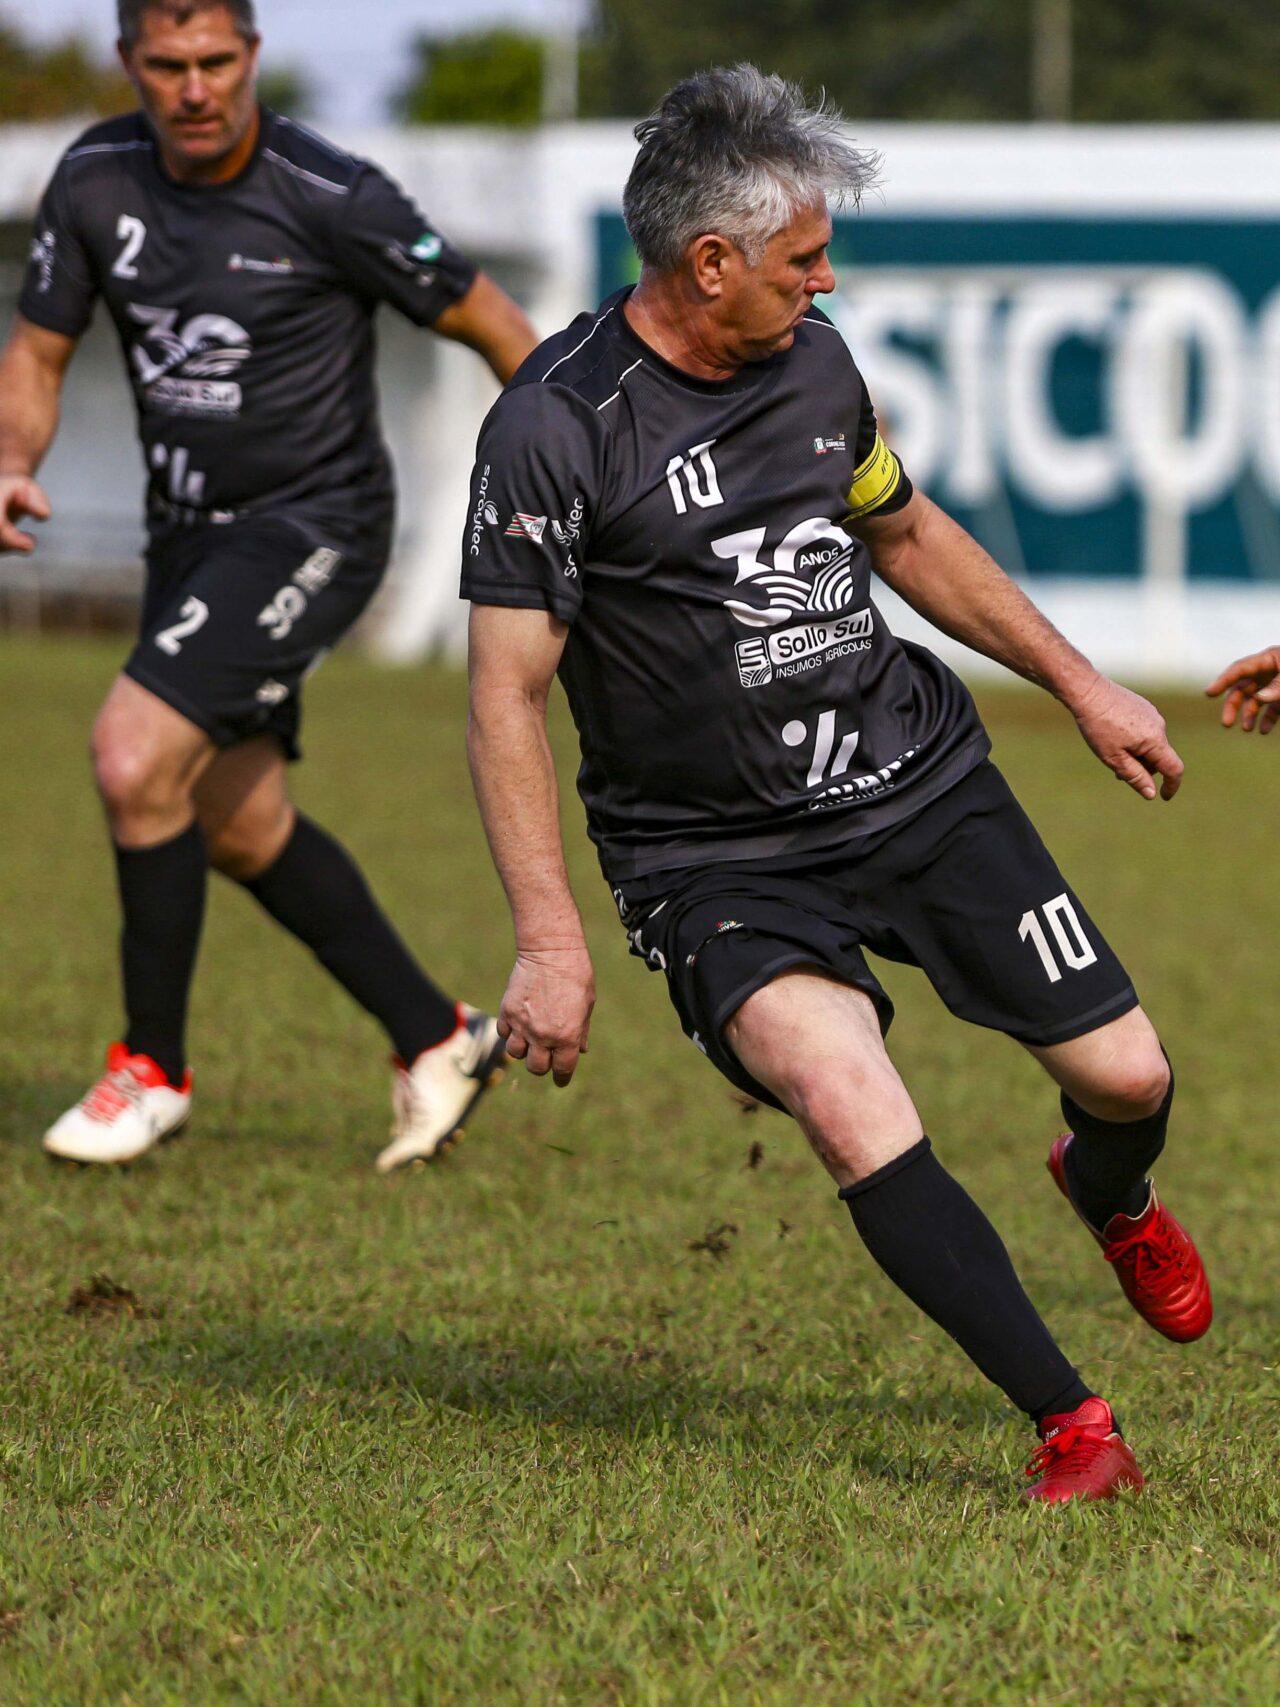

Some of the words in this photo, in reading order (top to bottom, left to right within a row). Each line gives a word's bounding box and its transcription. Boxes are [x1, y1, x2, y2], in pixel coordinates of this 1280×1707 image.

[112, 213, 147, 280] 2
[666, 438, 724, 515] 10
[799, 547, 839, 569] ANOS
[155, 595, 209, 656] 2
[777, 627, 827, 658] Sollo
[833, 618, 871, 638] Sul
[776, 656, 823, 679] INSUMOS
[825, 639, 872, 662] AGRÍCOLAS
[1017, 892, 1098, 983] 10
